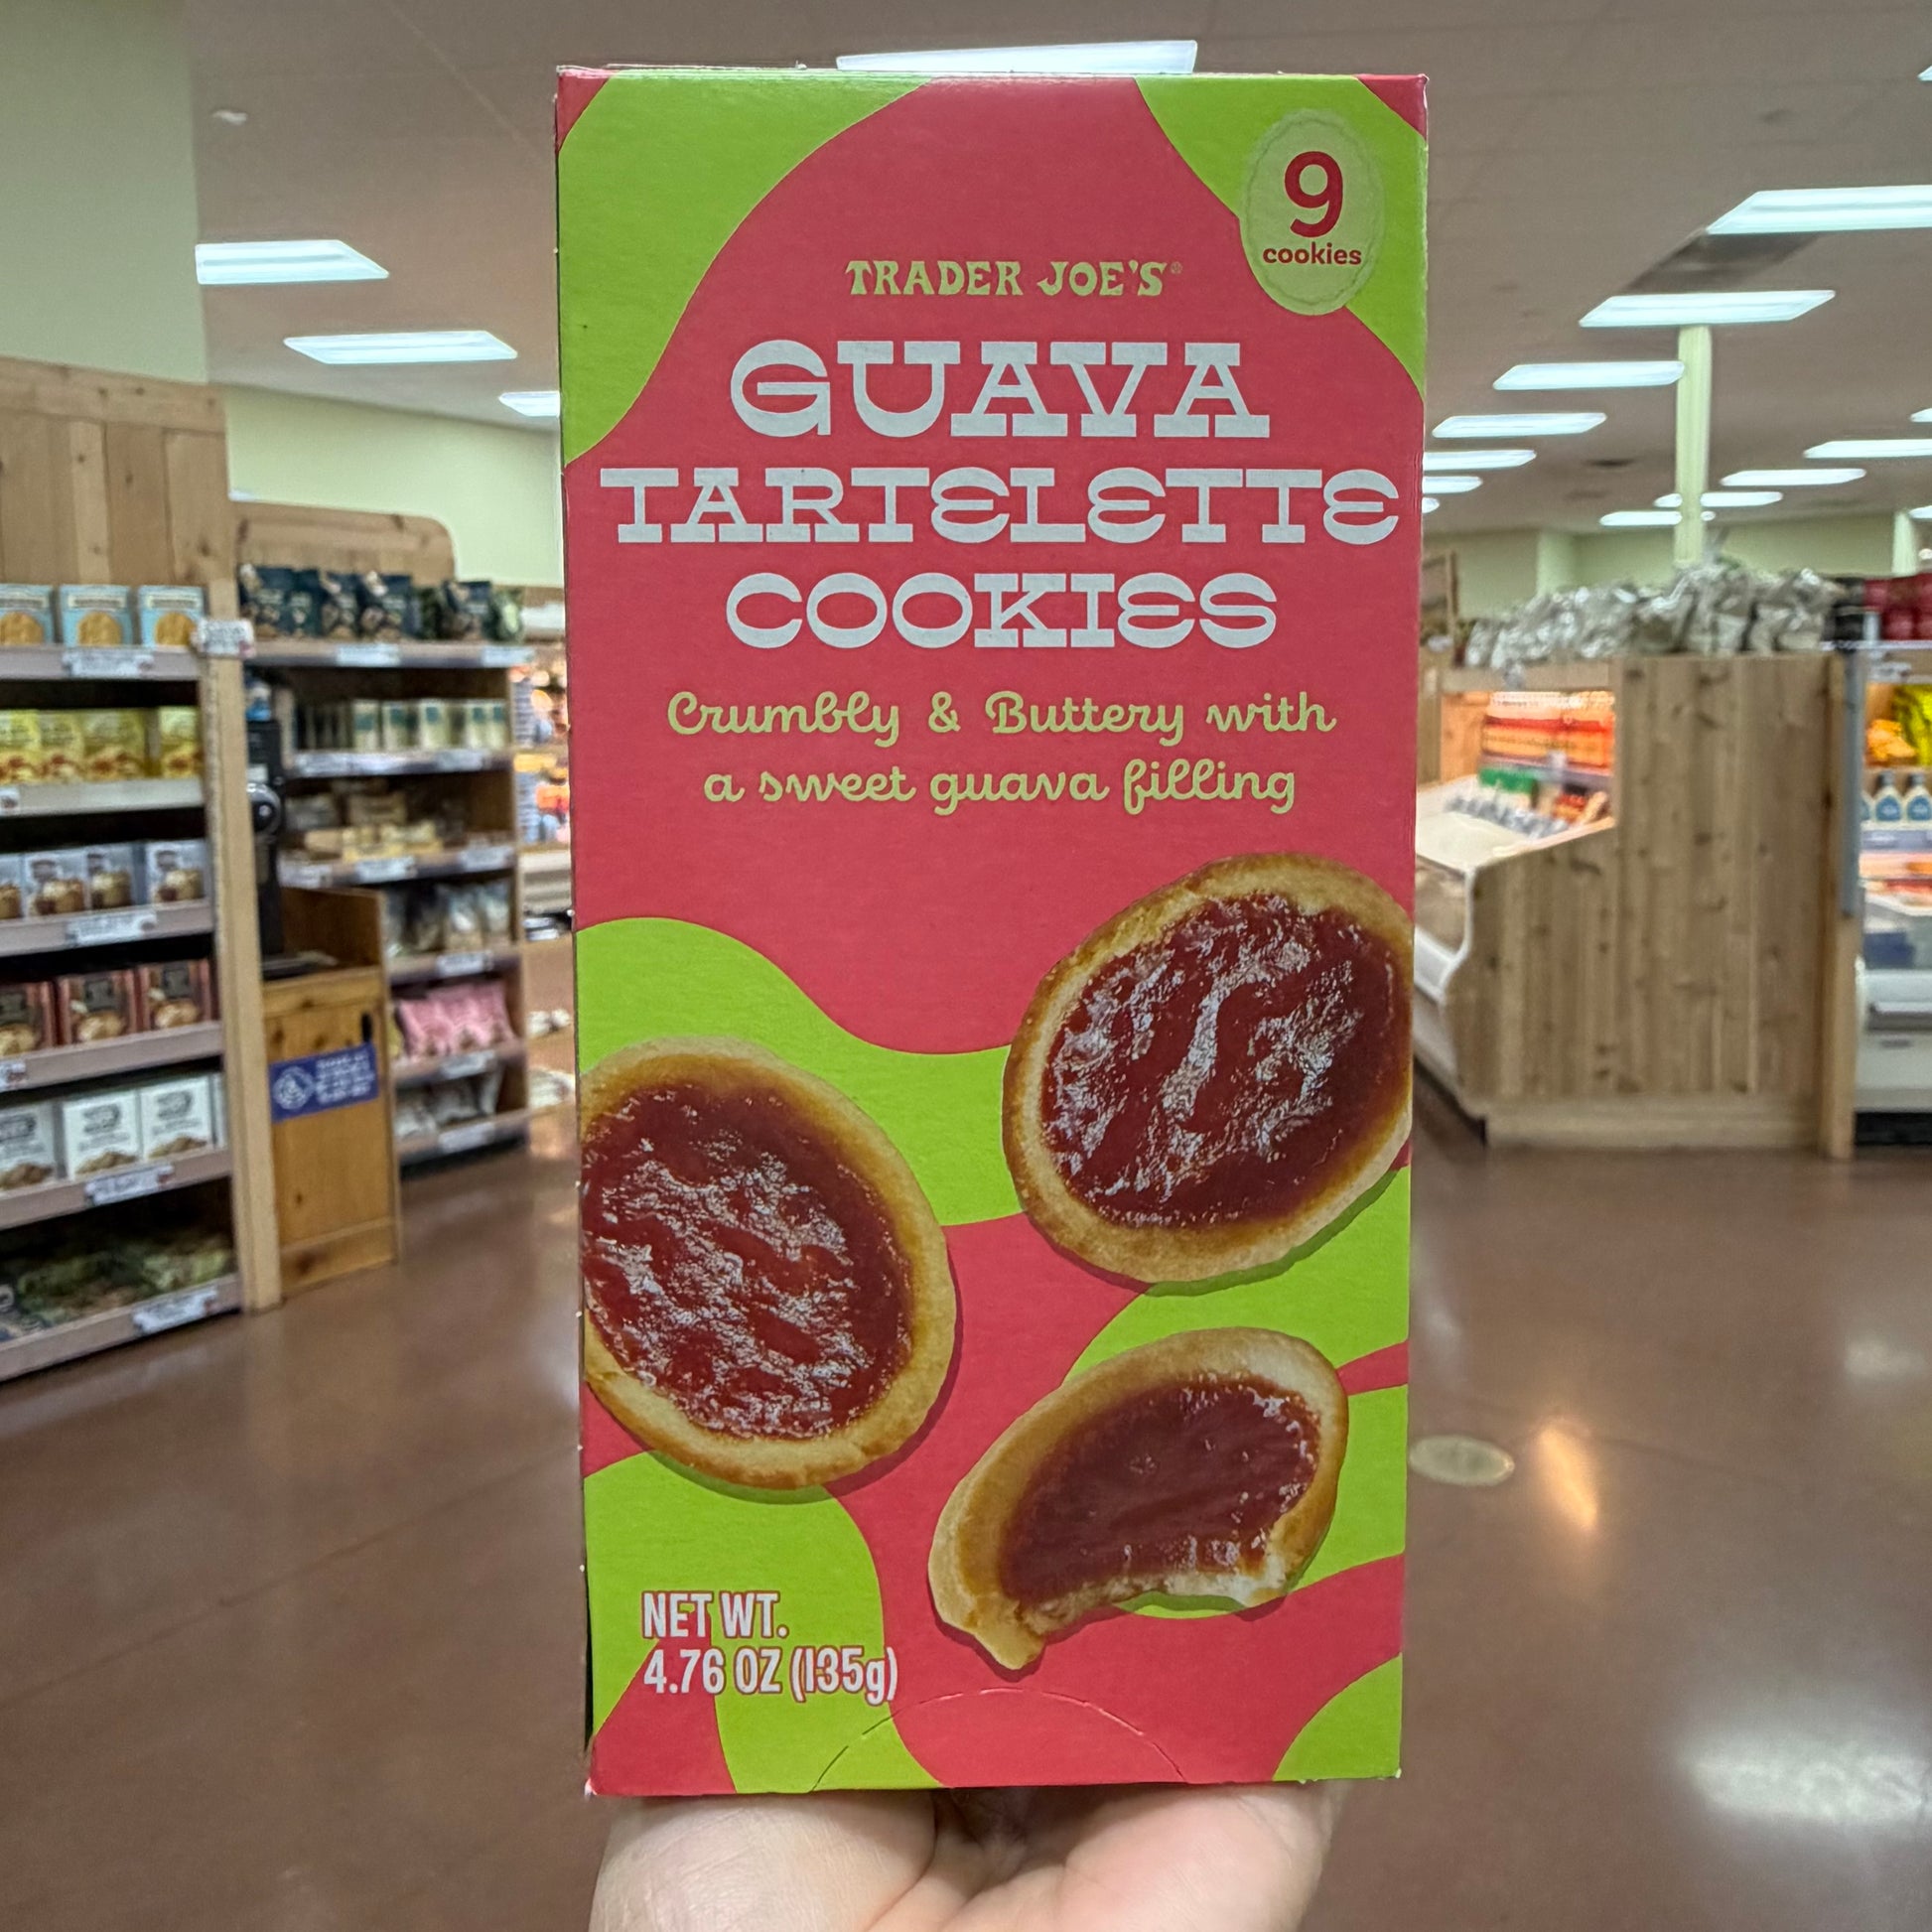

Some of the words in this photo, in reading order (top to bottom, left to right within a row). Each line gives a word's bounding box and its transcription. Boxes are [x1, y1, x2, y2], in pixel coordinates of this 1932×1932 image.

[1284, 151, 1343, 238] 9
[845, 260, 1023, 297] TRADER
[1037, 260, 1167, 297] JOE'S
[1262, 243, 1362, 265] cookies
[730, 339, 1271, 439] GUAVA
[600, 467, 1399, 545] TARTELETTE
[726, 572, 1277, 649] COOKIES
[666, 691, 899, 749] Crumbly
[927, 691, 960, 734] &
[984, 690, 1184, 748] Buttery
[1205, 691, 1337, 734] with
[703, 773, 745, 802] a
[759, 766, 916, 802] sweet
[929, 772, 1110, 816] guava
[1123, 759, 1296, 815] filling
[642, 1591, 713, 1639] NET
[720, 1591, 789, 1639] WT.
[643, 1647, 726, 1695] 4.76
[733, 1648, 783, 1694] OZ
[790, 1645, 897, 1706] (135g)
